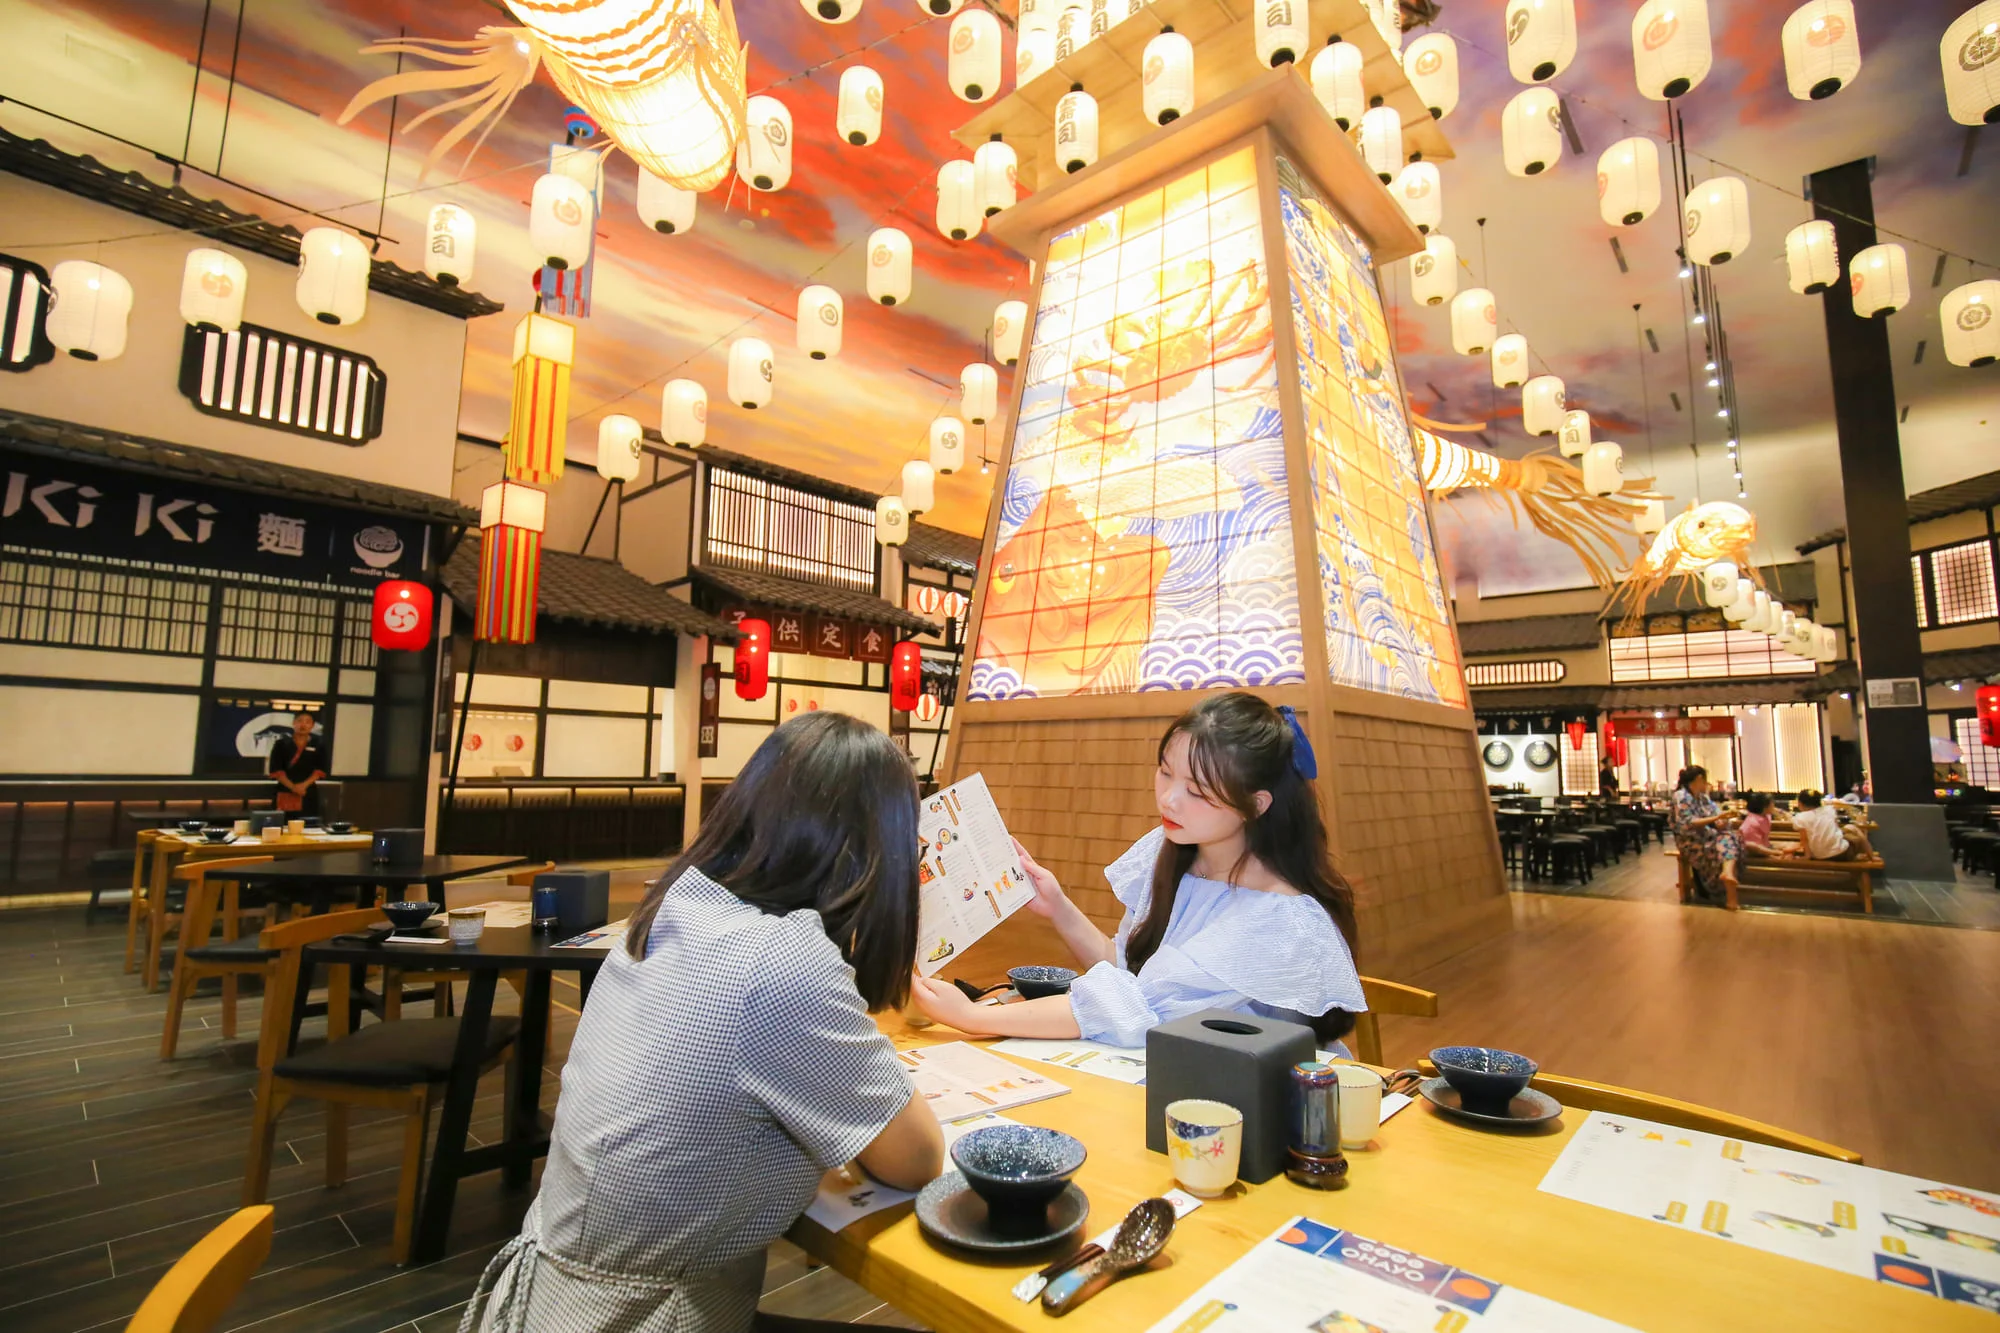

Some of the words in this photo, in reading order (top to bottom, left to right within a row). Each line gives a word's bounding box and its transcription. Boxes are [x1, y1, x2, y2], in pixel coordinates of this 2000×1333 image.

[349, 566, 383, 577] noodle
[384, 569, 401, 579] bar
[1340, 1247, 1425, 1282] OHAYO
